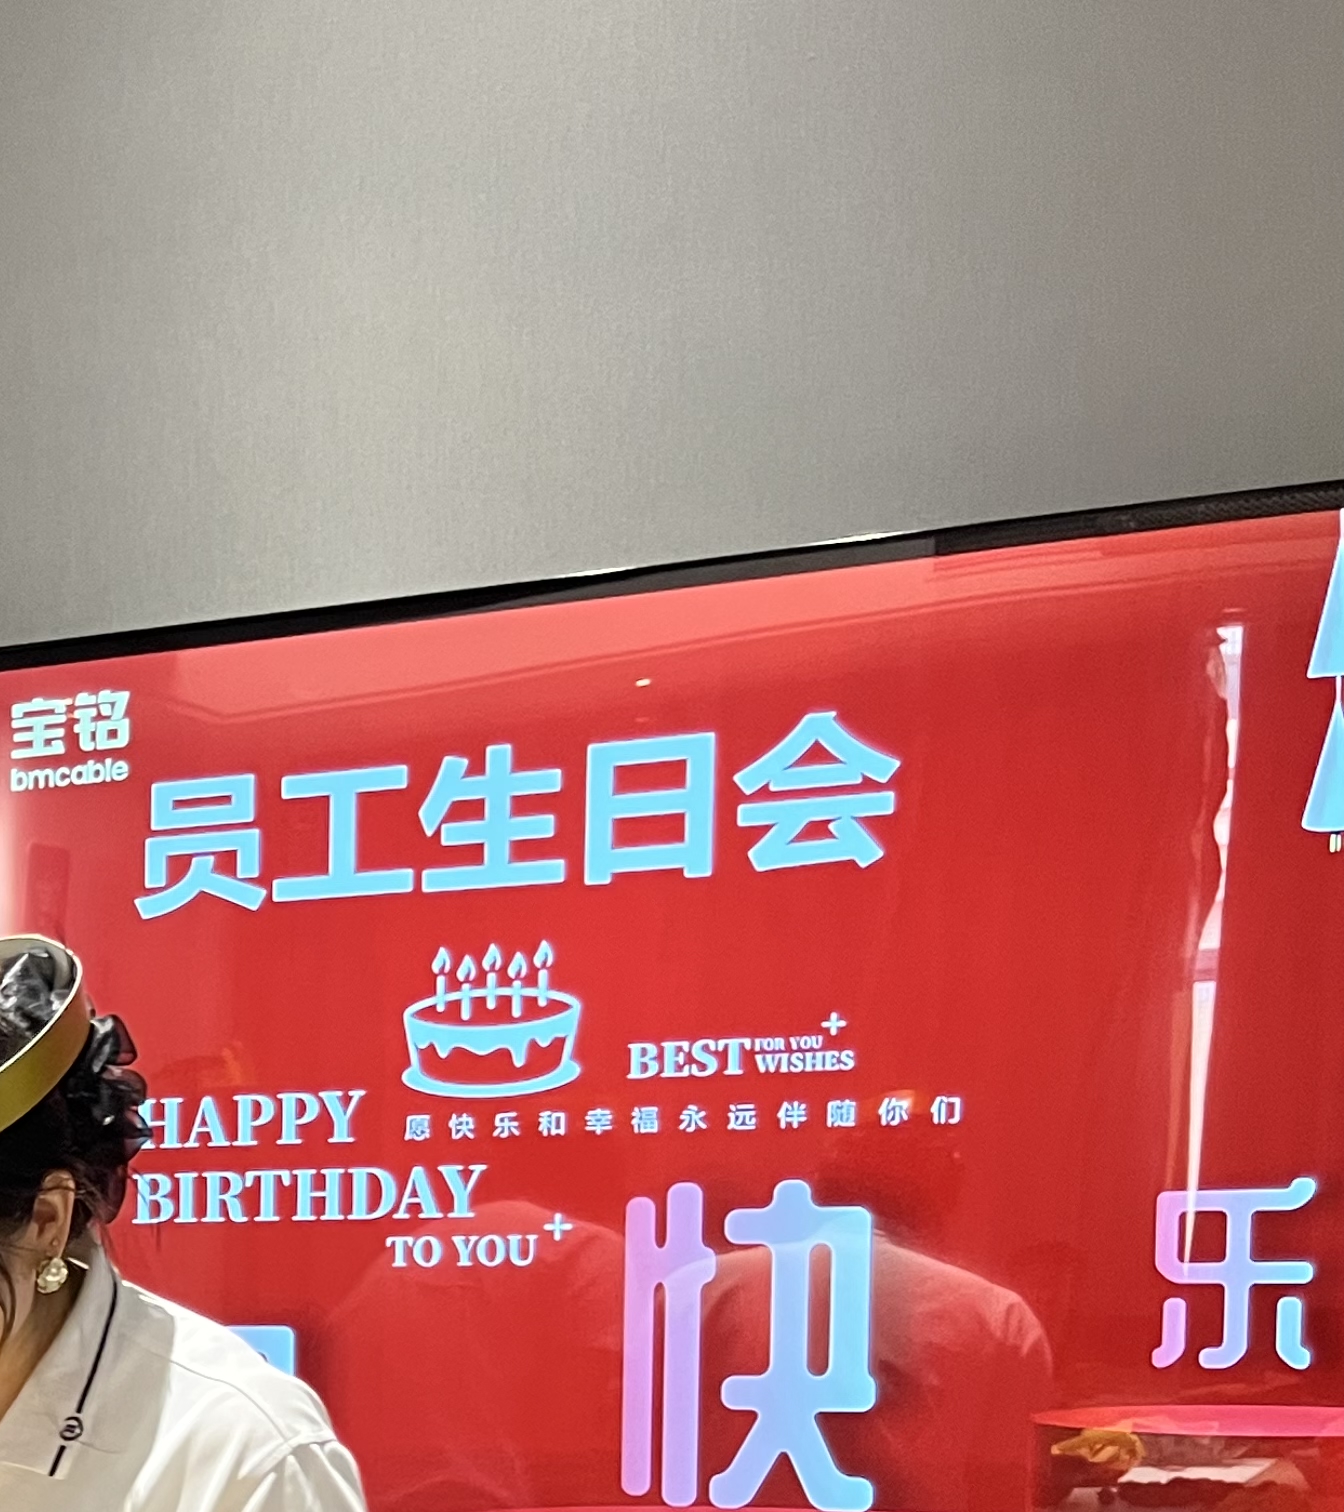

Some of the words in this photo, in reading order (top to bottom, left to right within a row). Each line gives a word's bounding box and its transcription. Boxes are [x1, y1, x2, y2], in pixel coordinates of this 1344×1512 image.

[10, 690, 130, 760] 宝铭
[10, 758, 130, 792] bmcable
[134, 710, 902, 921] 员工生日会
[626, 1038, 752, 1080] BEST
[754, 1037, 785, 1052] FOR
[789, 1035, 823, 1051] YOU
[754, 1050, 855, 1074] WISHES
[138, 1090, 366, 1150] HAPPY
[403, 1095, 963, 1142] 愿快乐和幸福永远伴随你们
[131, 1164, 488, 1225] BIRTHDAY
[386, 1236, 443, 1268] TO
[451, 1234, 539, 1268] YOU
[1151, 1177, 1317, 1370] 乐
